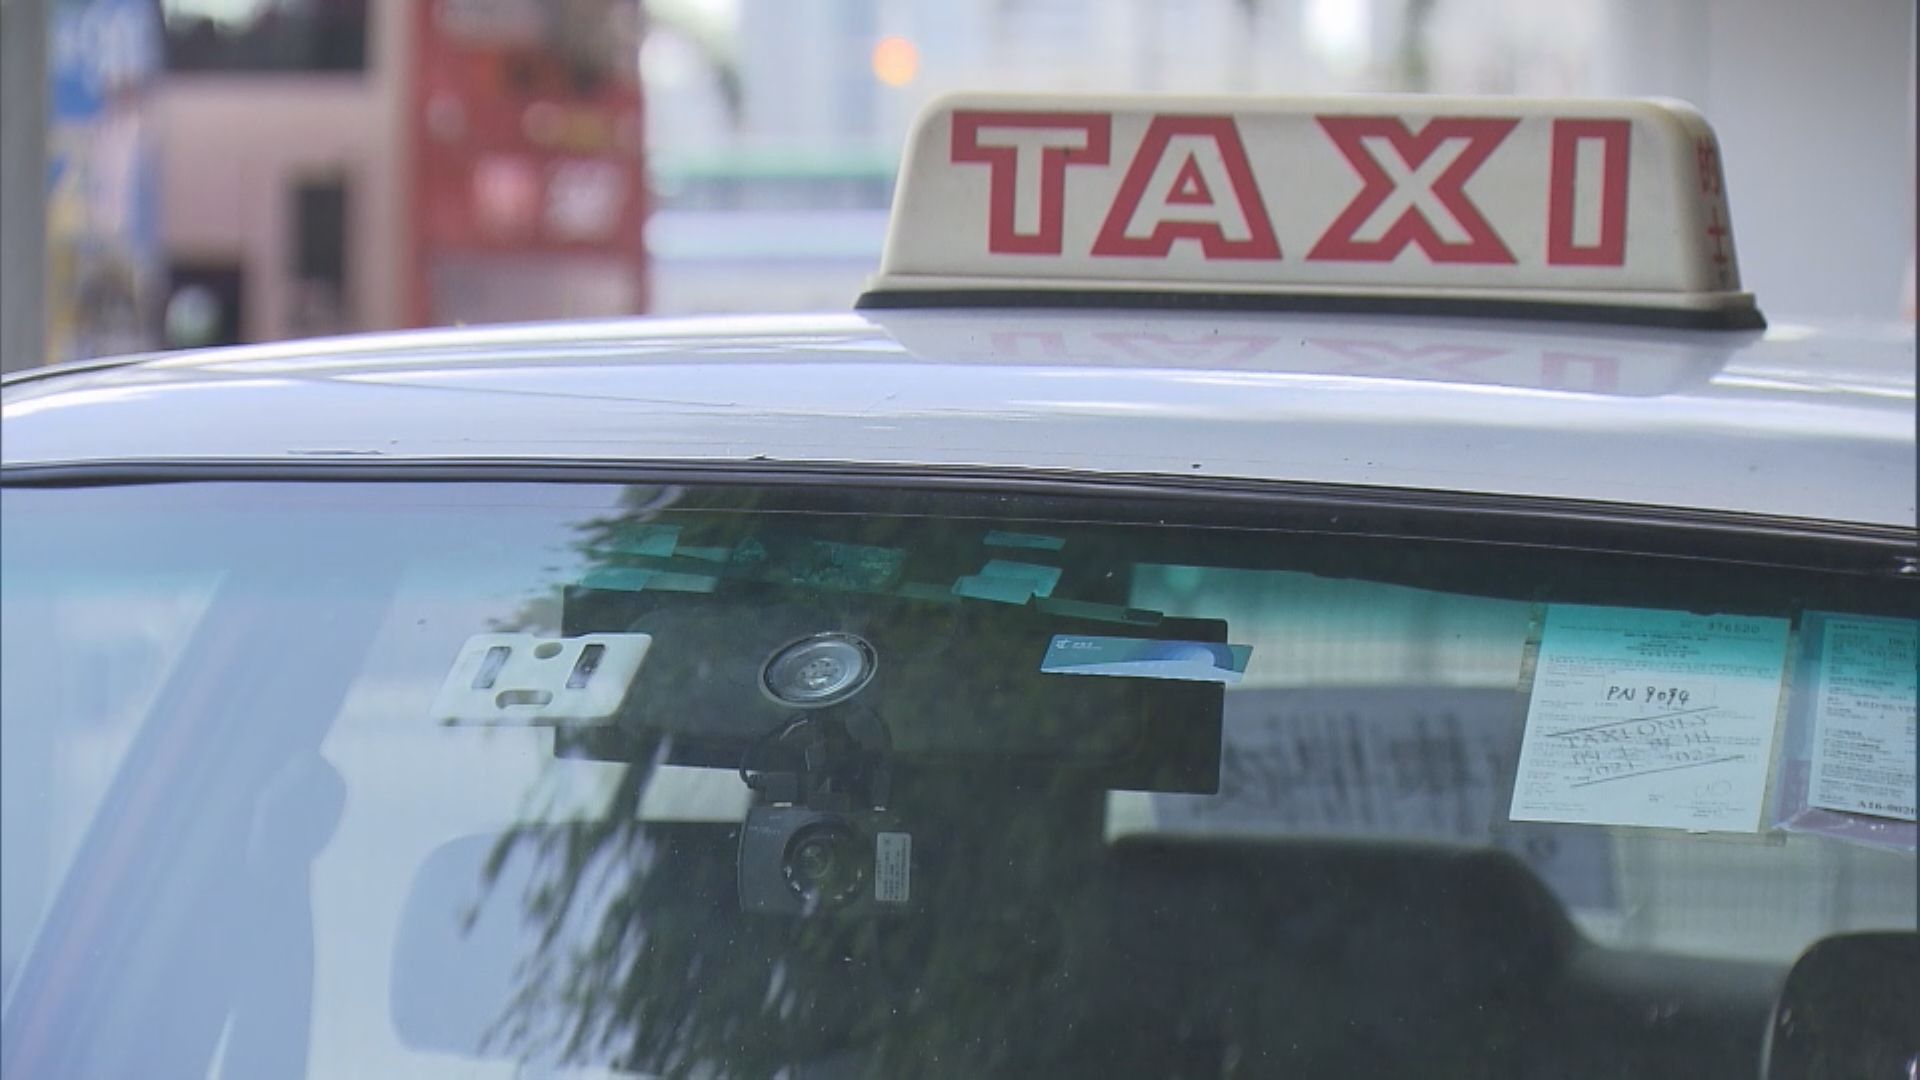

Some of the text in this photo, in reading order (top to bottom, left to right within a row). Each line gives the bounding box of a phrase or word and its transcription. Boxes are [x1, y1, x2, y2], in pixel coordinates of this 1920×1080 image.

[951, 111, 1632, 267] TAXI
[1606, 686, 1636, 701] PN
[1563, 714, 1707, 750] TAXI ONLY
